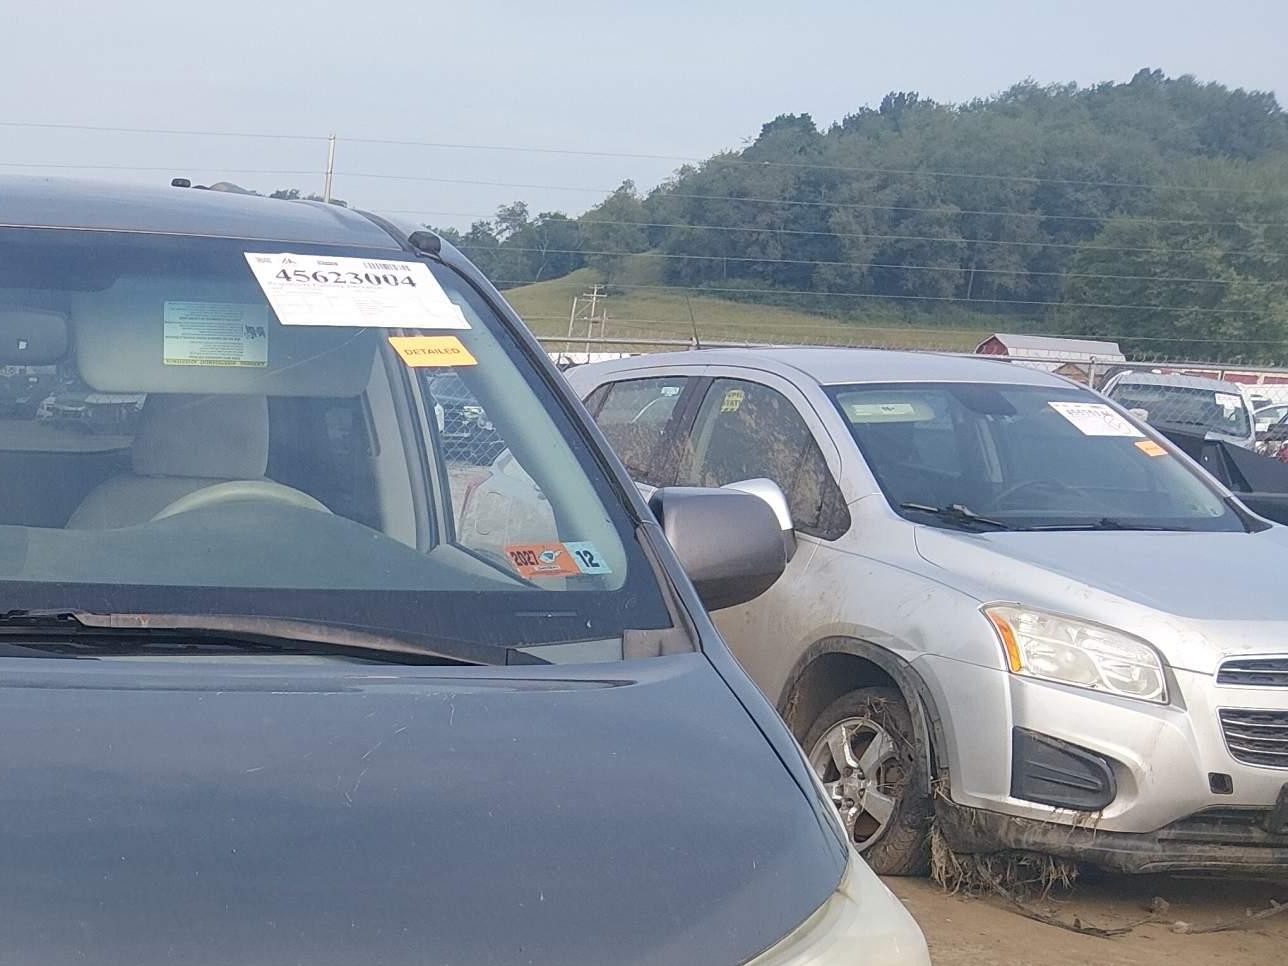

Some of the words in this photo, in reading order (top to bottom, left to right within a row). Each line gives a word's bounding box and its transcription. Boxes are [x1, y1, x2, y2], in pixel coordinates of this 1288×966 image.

[274, 267, 417, 288] 45623004
[403, 346, 461, 356] DETAILED
[510, 550, 539, 566] 2027
[575, 550, 601, 568] 12
